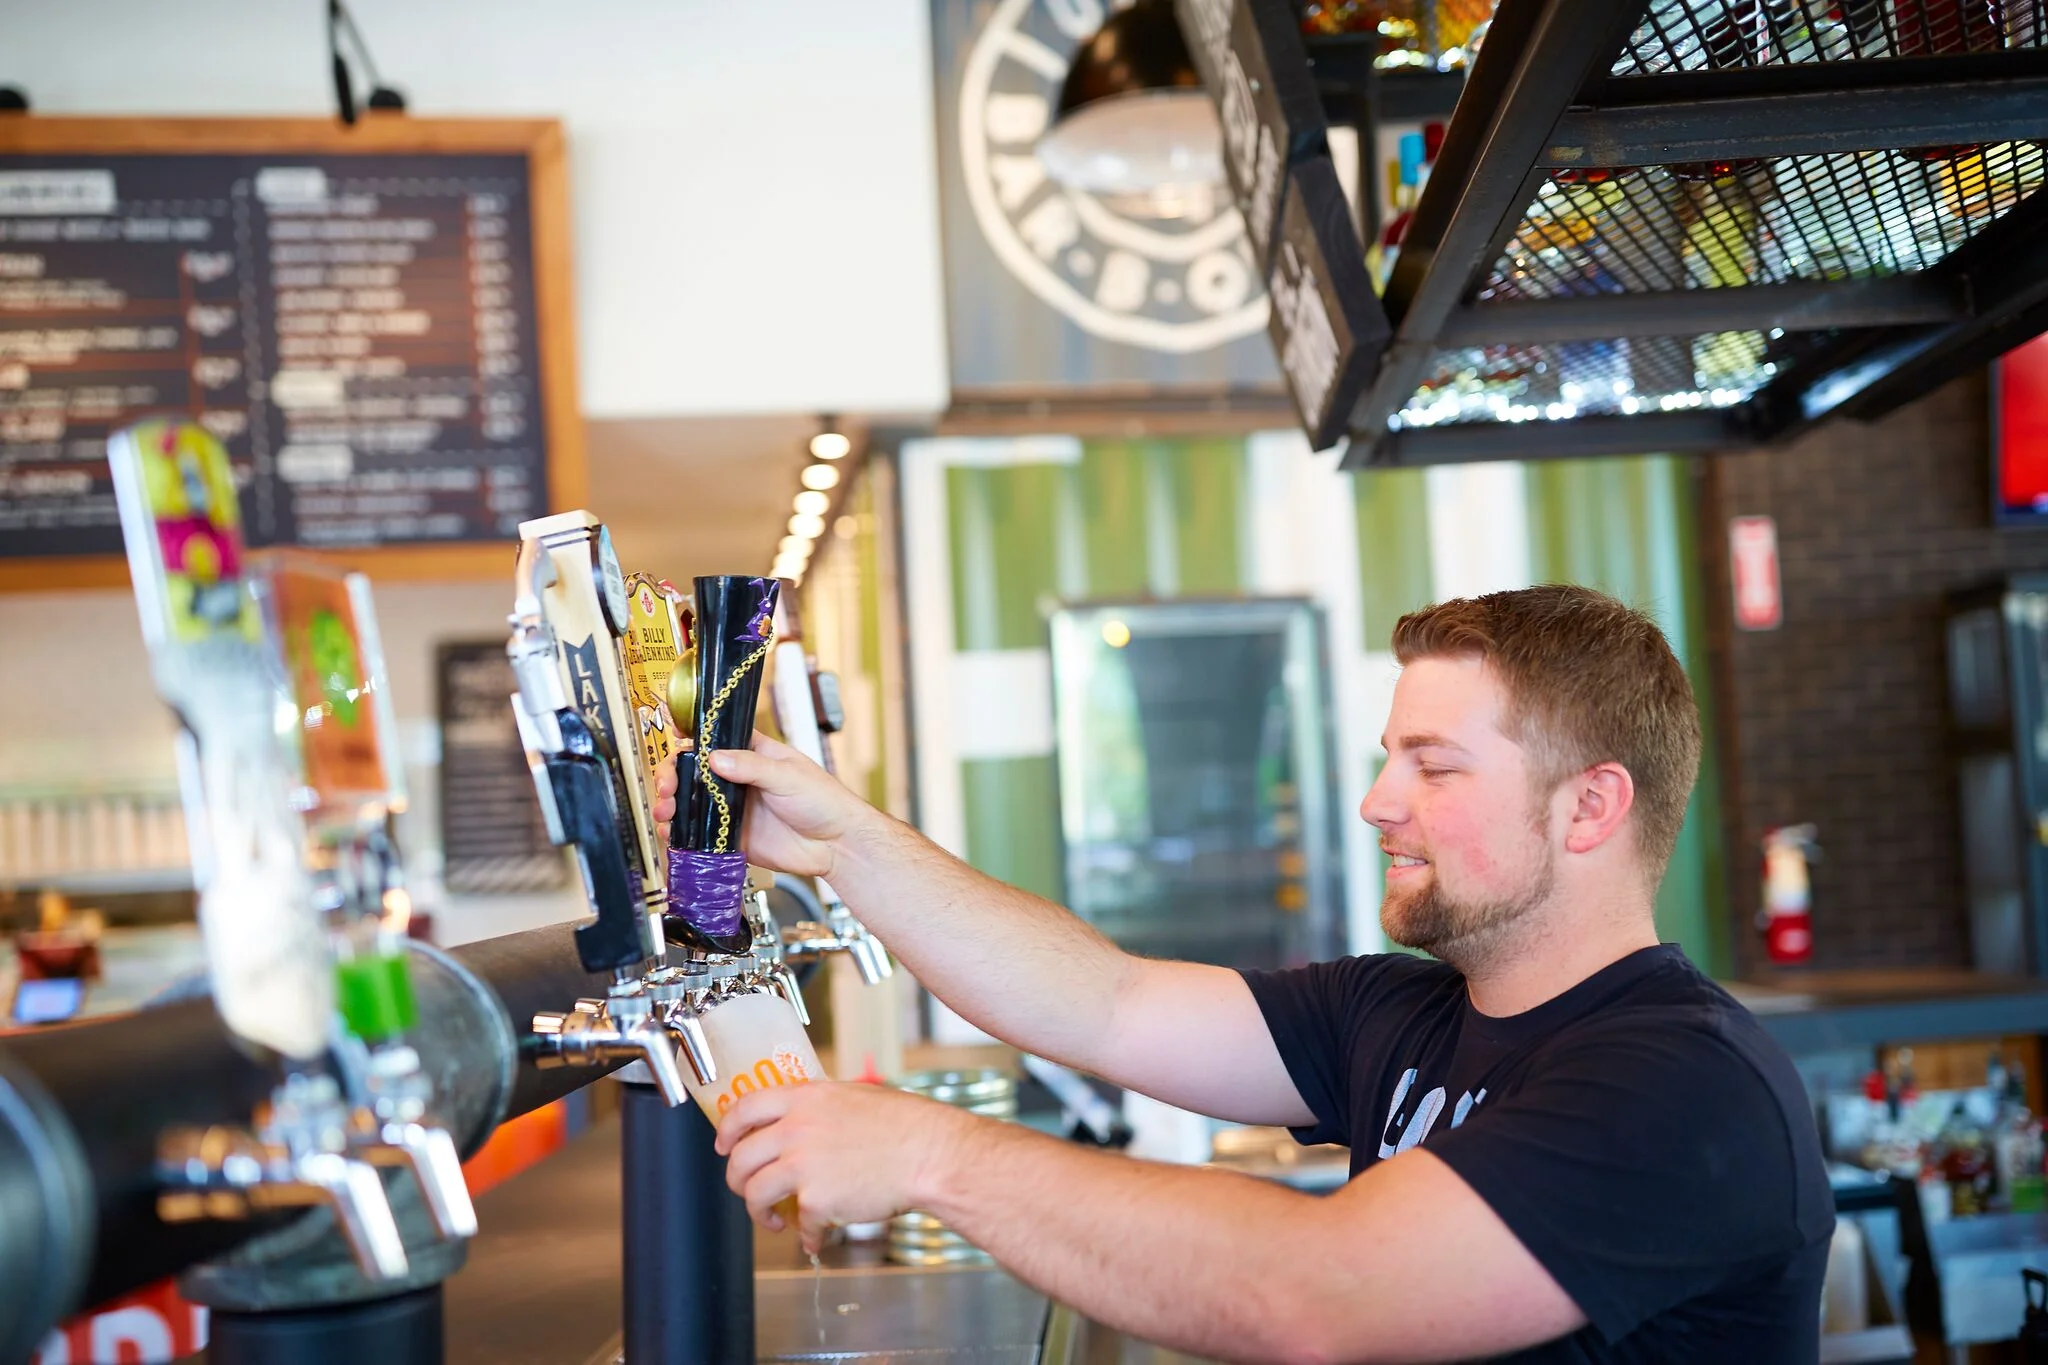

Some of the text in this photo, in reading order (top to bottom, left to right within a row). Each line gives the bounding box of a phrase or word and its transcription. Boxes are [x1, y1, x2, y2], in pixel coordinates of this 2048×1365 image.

[642, 627, 666, 644] BILLY
[641, 645, 676, 662] JENKINS
[574, 653, 606, 738] LAK
